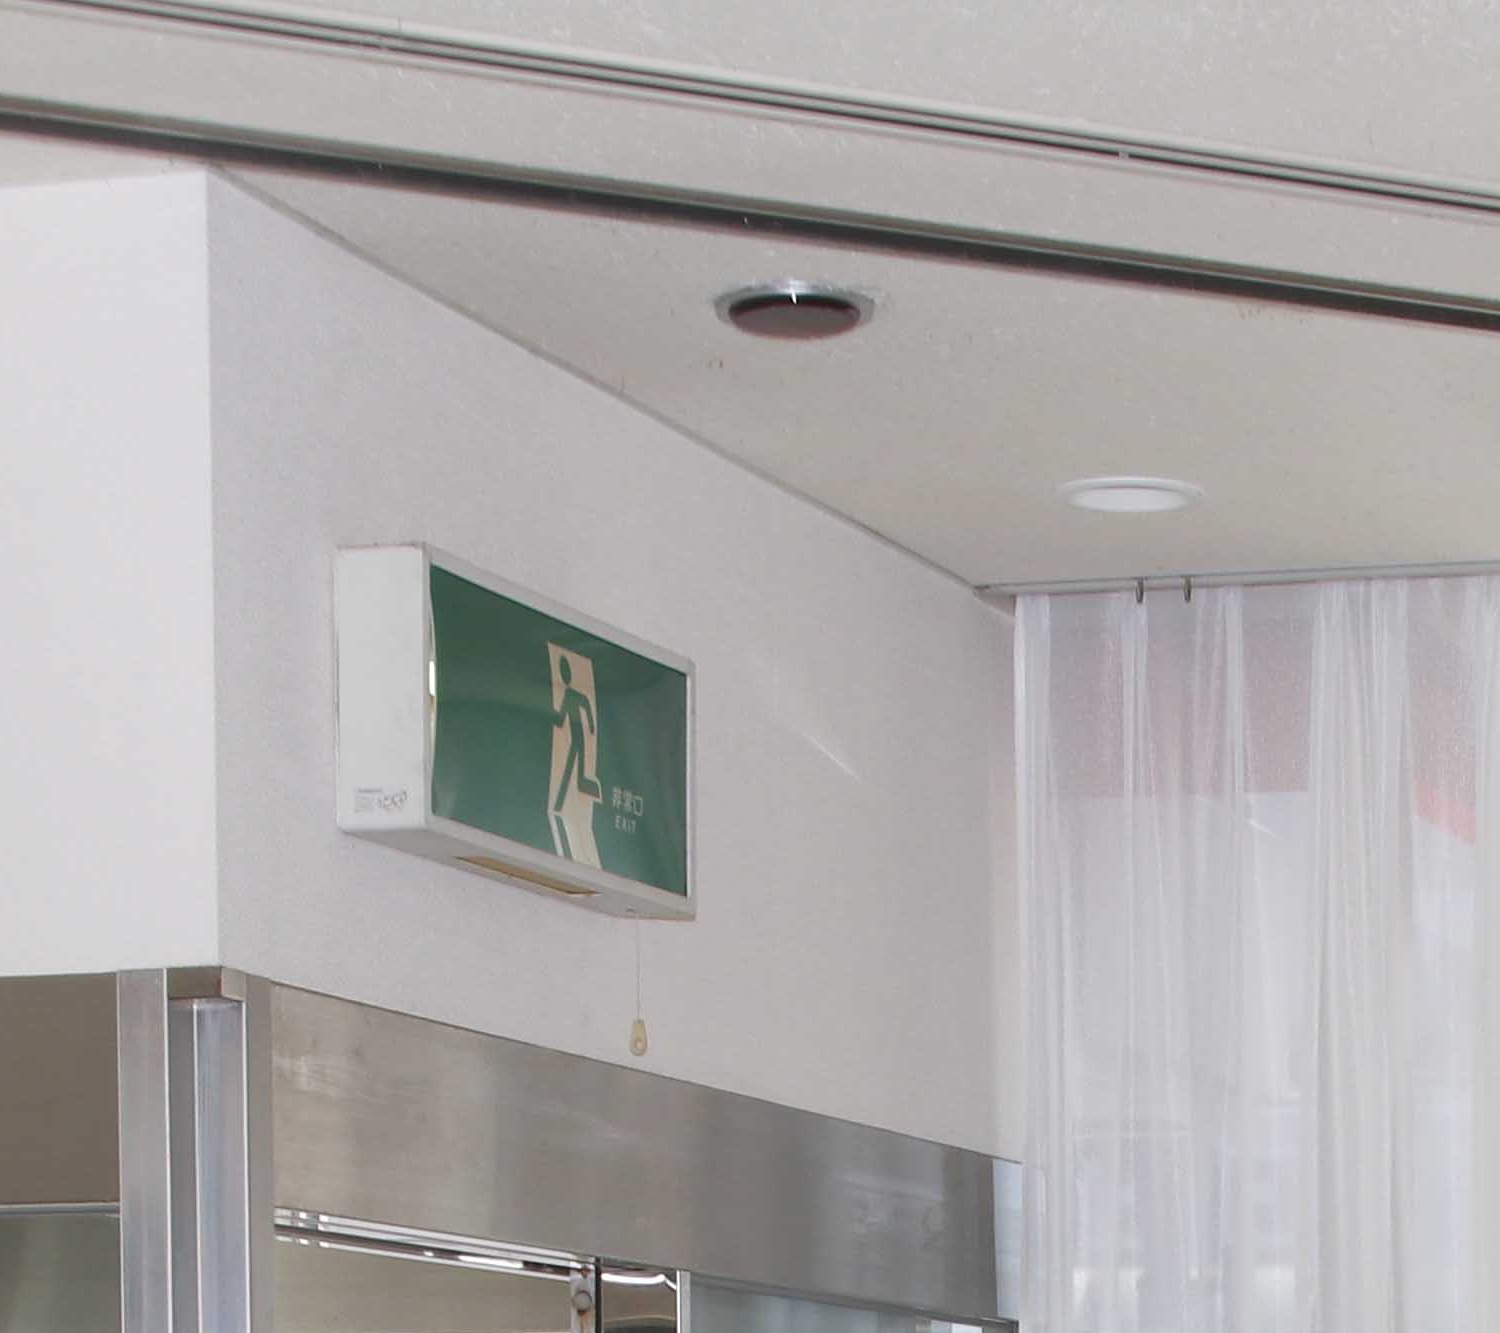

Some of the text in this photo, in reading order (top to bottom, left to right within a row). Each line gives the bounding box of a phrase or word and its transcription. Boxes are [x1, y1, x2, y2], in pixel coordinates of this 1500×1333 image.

[612, 786, 643, 816] 非常口
[614, 814, 637, 833] EXIT
